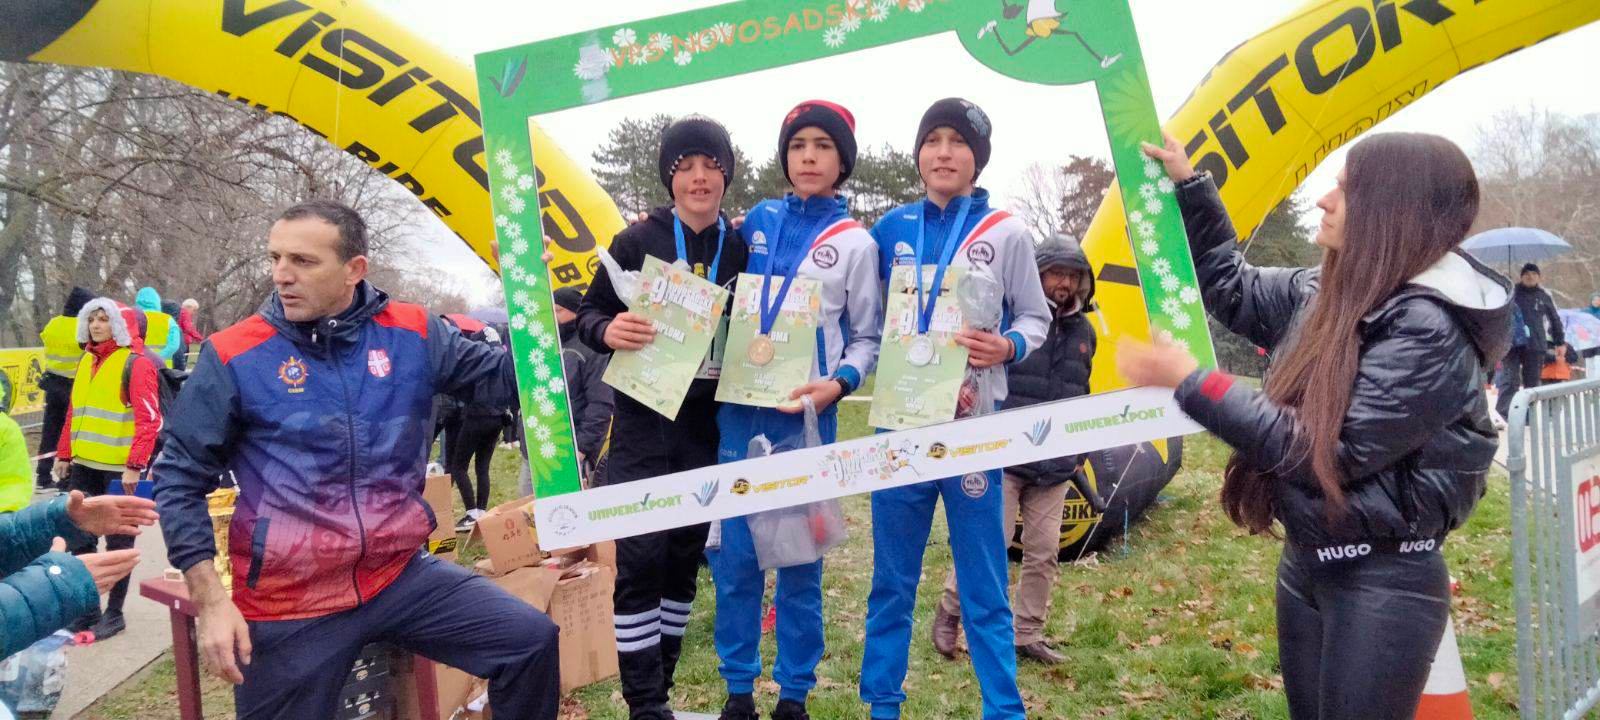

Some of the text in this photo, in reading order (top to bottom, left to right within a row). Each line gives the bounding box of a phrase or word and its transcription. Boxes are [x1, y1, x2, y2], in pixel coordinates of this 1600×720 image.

[588, 493, 682, 521] UNIVEREXPORT
[1064, 405, 1164, 433] UNIVEREXPORT
[1317, 543, 1371, 562] HUGO
